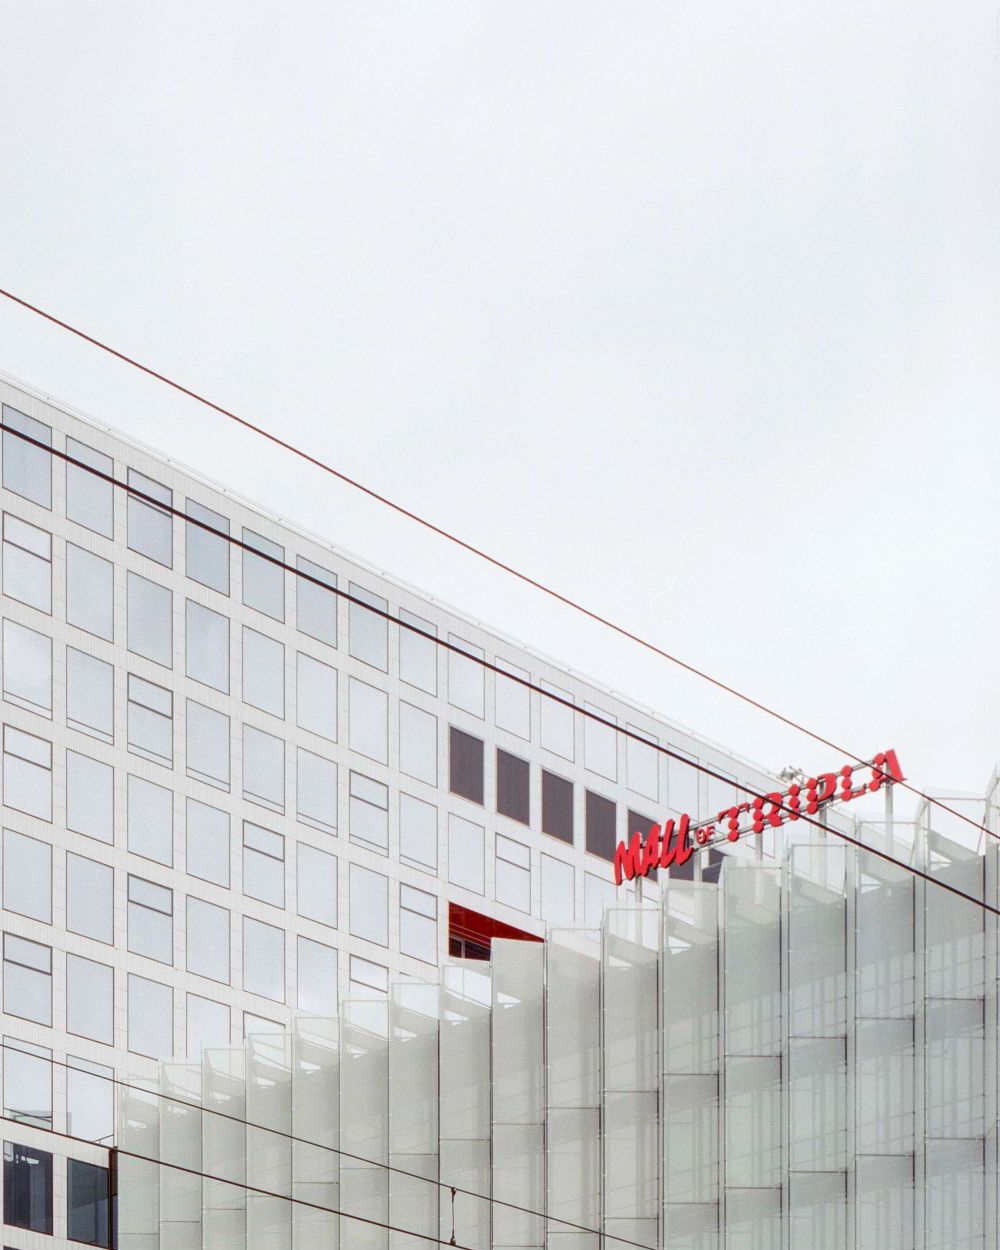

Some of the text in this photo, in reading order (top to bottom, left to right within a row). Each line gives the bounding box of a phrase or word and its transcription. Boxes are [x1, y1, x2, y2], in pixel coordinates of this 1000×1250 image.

[614, 749, 904, 886] MALL OF TRIPLA
